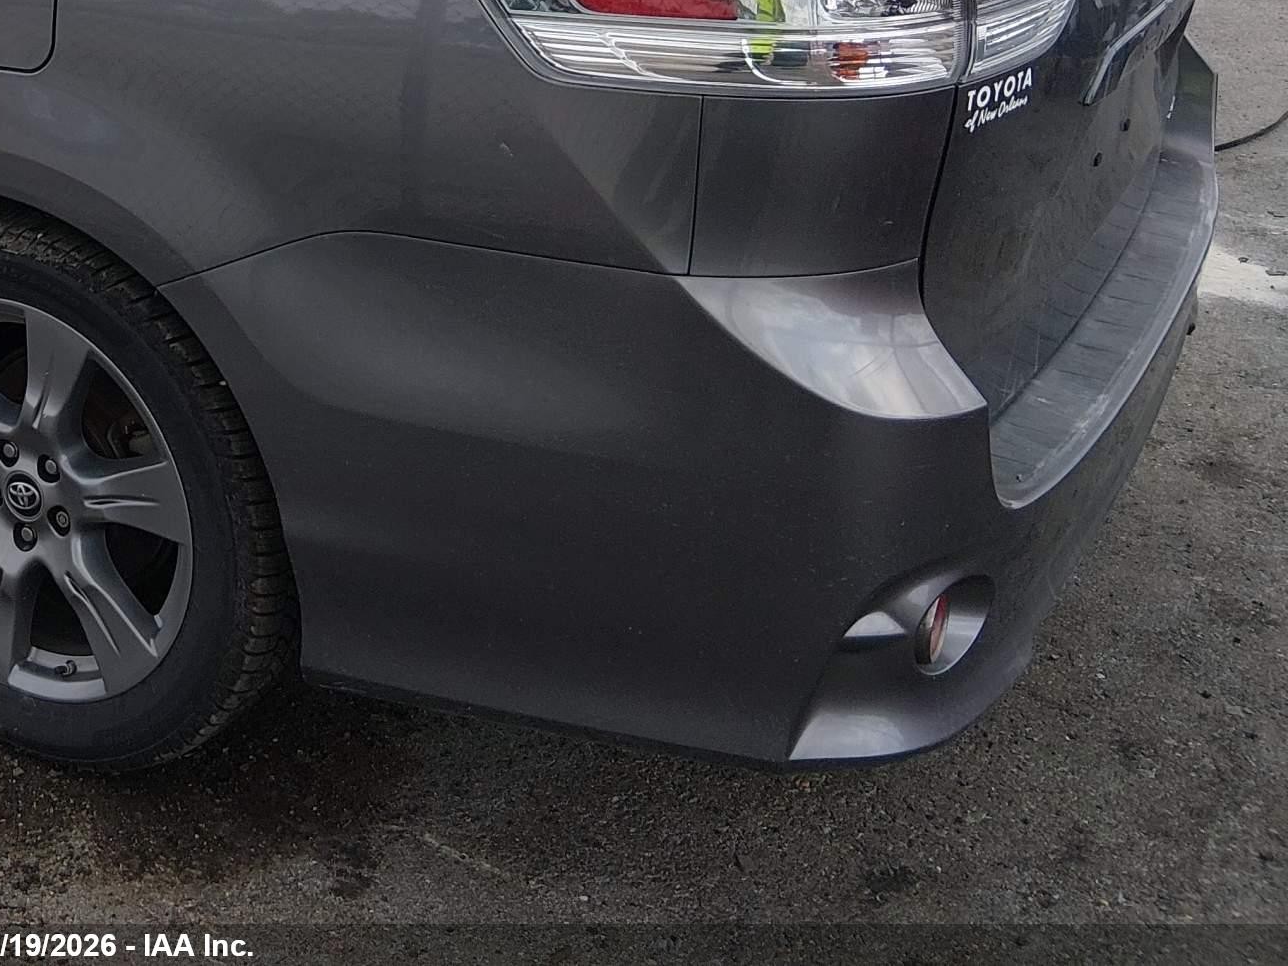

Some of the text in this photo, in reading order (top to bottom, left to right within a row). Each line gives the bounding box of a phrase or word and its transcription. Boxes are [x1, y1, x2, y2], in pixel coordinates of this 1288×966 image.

[967, 67, 1032, 111] TOYOTA
[964, 95, 1028, 133] of New Orleans
